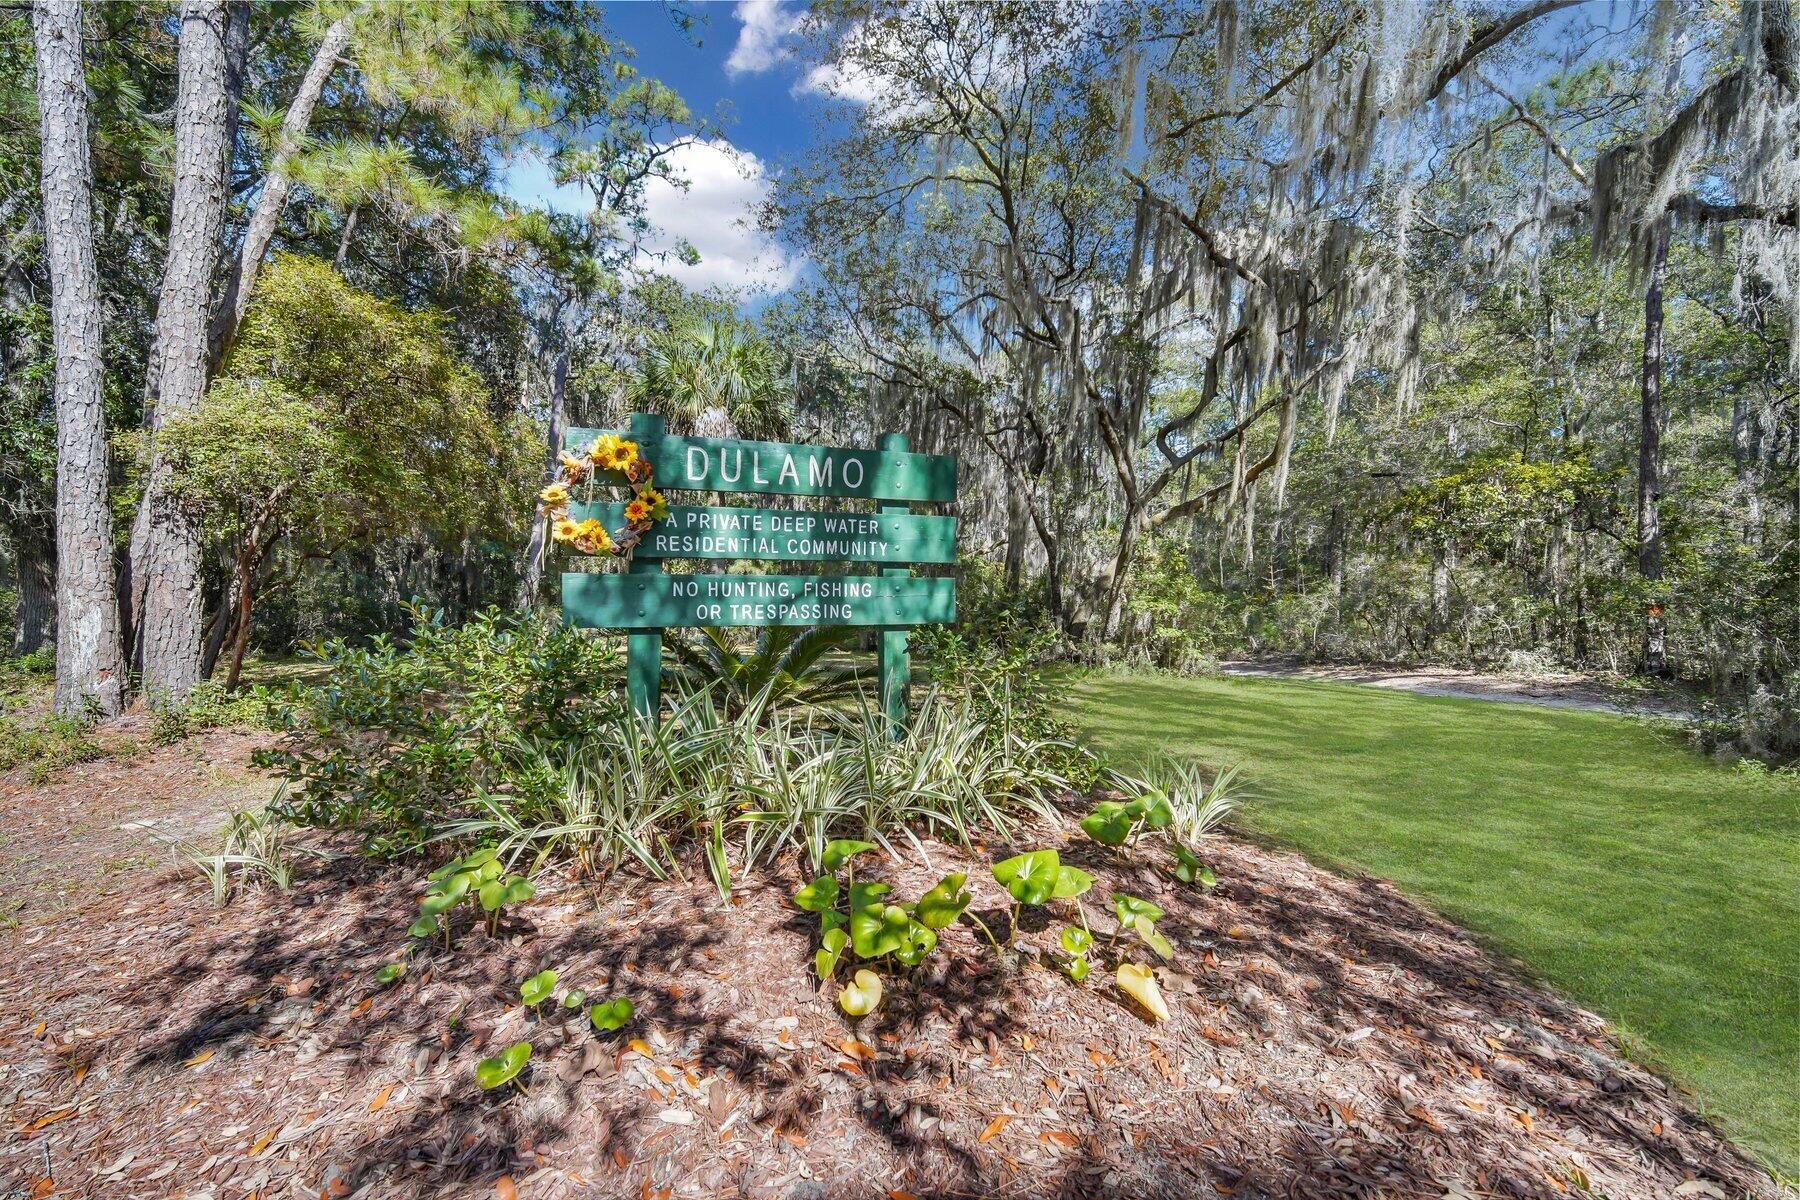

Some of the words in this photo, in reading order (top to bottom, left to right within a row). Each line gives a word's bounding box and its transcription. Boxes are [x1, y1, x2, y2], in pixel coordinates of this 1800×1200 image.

[686, 447, 864, 489] DULAMO
[665, 513, 678, 528] A
[687, 513, 762, 531] PRIVATE
[771, 516, 816, 532] DEEP
[824, 519, 879, 535] WATER
[656, 536, 778, 554] RESIDENTIAL
[787, 539, 888, 557] COMMUNITY
[672, 582, 698, 597] NO
[708, 582, 796, 599] HUNTING,
[804, 582, 872, 597] FISHING
[696, 605, 721, 620] OR
[730, 604, 852, 620] TRESPASSING
